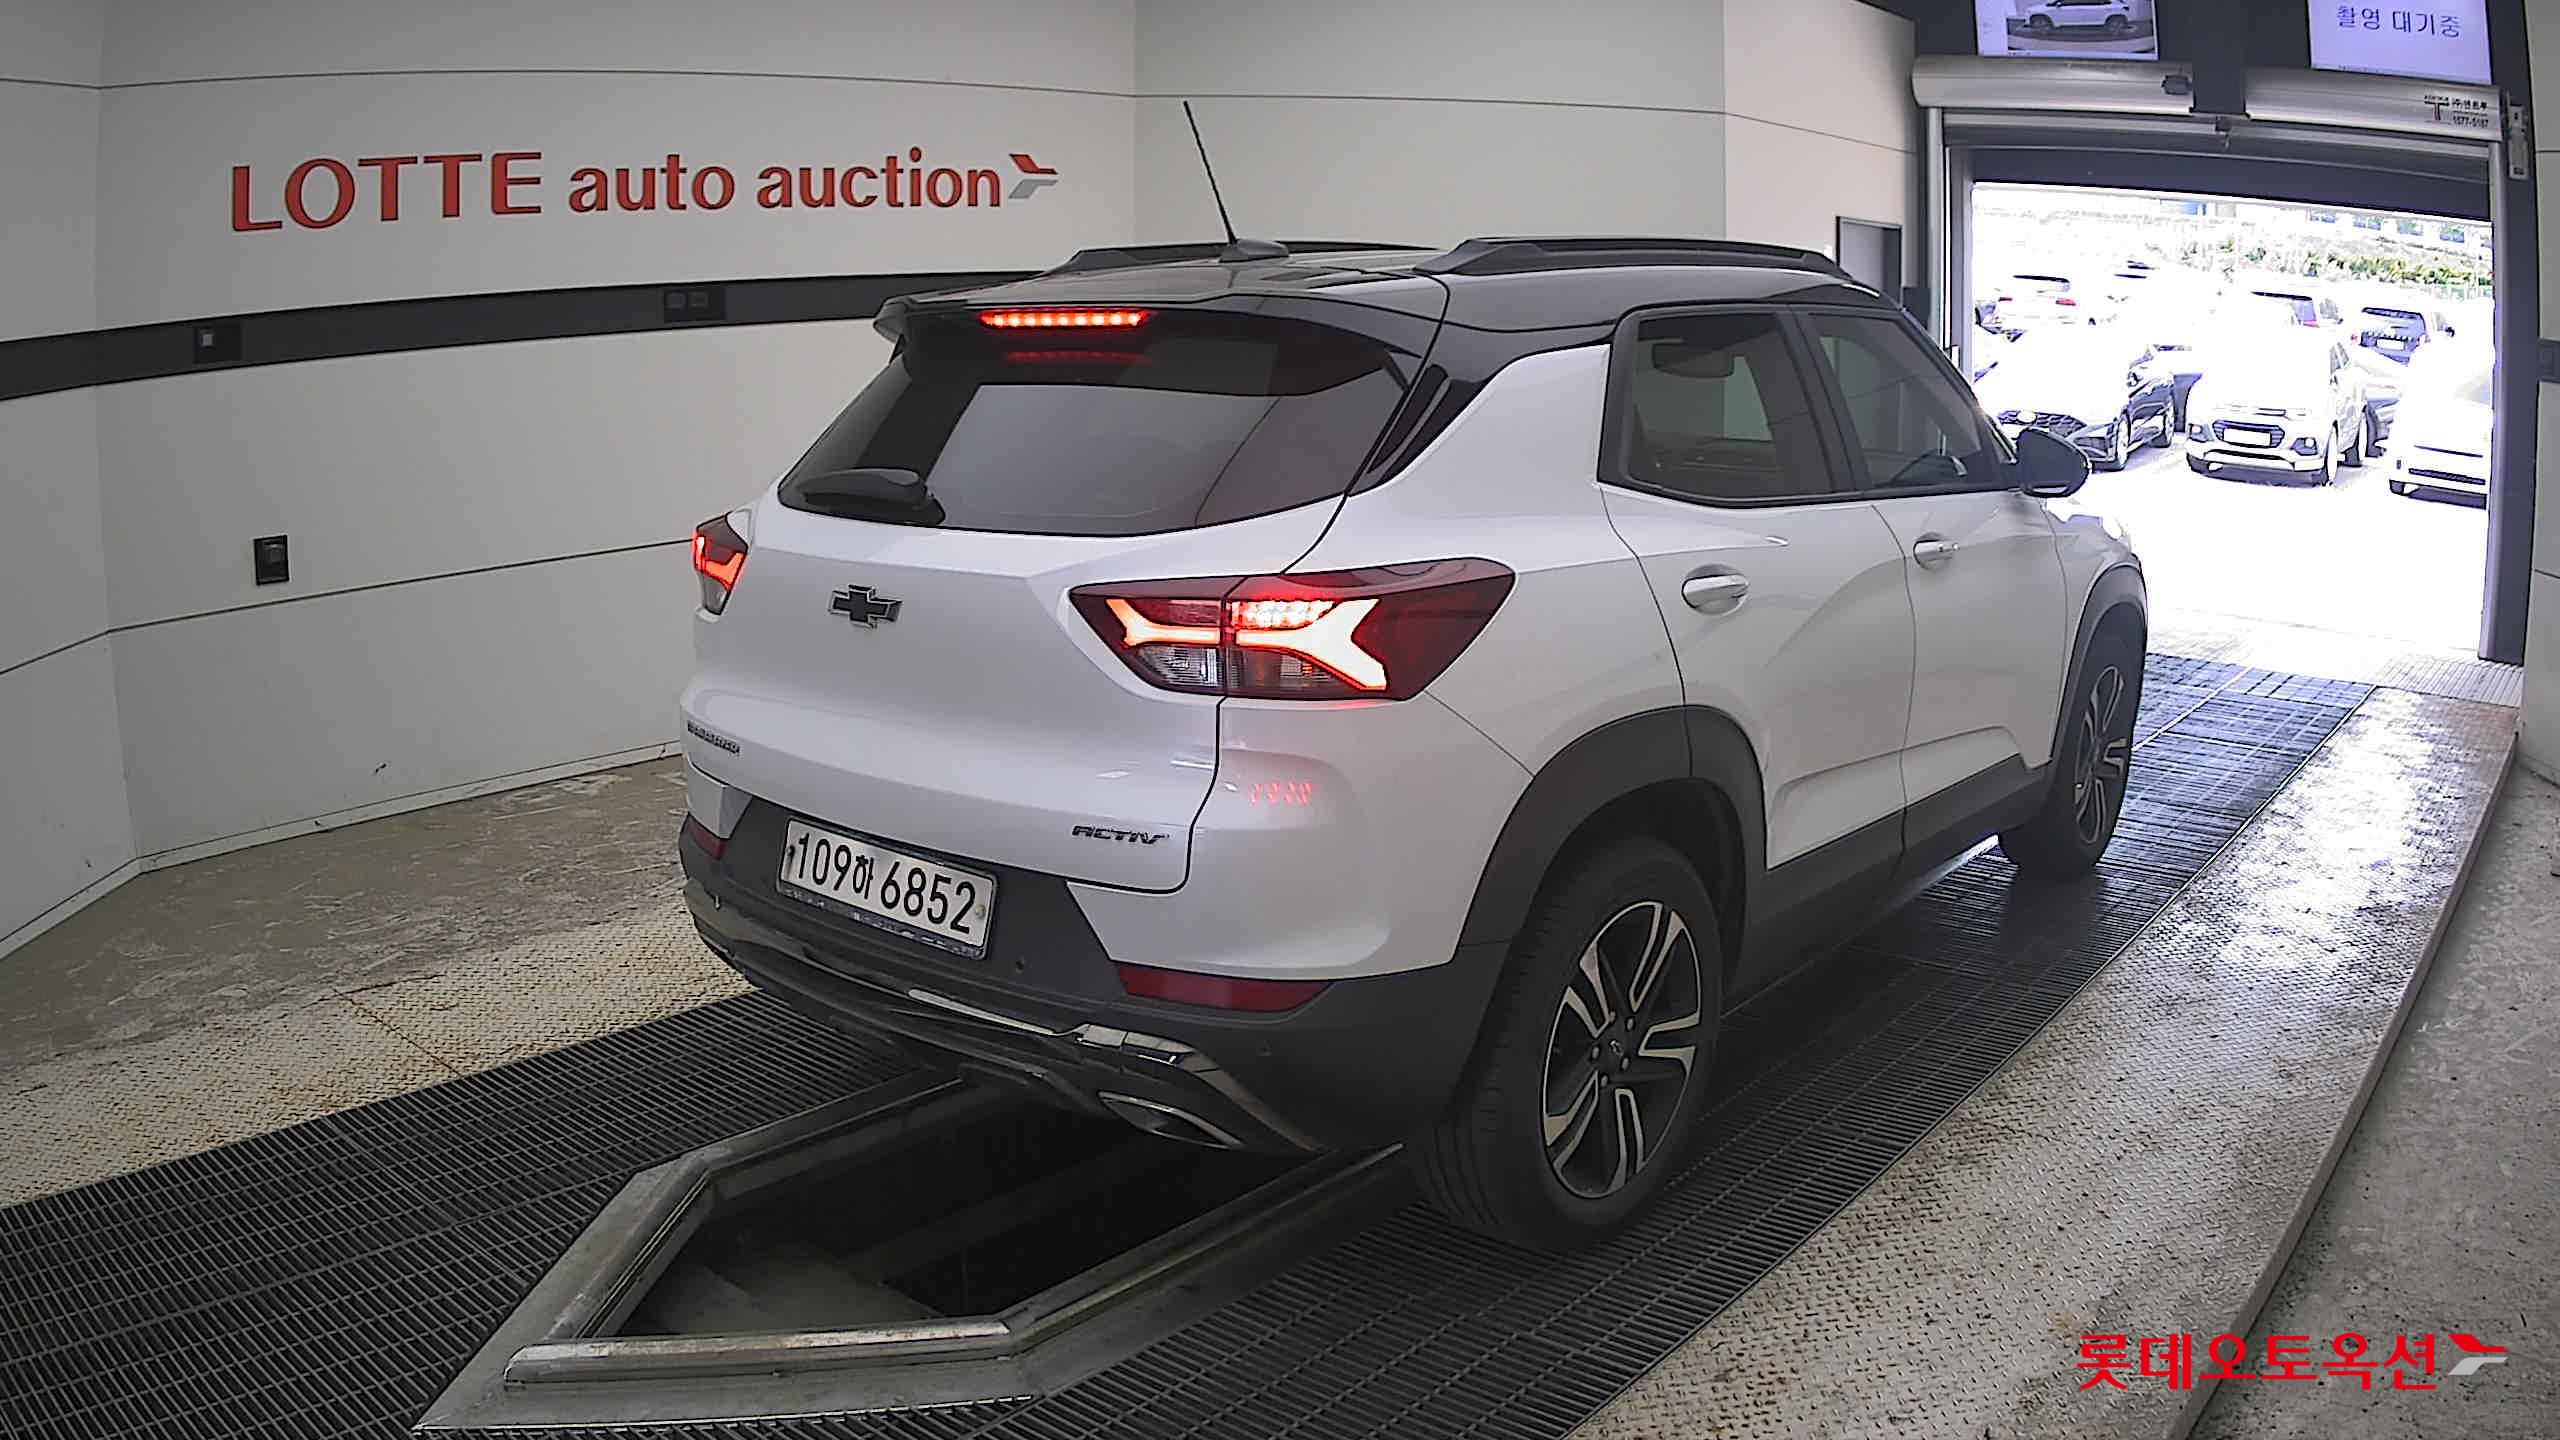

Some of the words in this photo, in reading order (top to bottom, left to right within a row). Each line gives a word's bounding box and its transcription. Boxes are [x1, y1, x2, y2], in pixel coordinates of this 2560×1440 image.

[2338, 6, 2380, 31] 촬영
[2392, 11, 2461, 39] 대기중
[231, 154, 541, 233] LOTTE
[568, 153, 737, 214] auto
[757, 146, 1003, 210] auction
[1071, 825, 1166, 844] ACTIV
[880, 861, 977, 935] 6852
